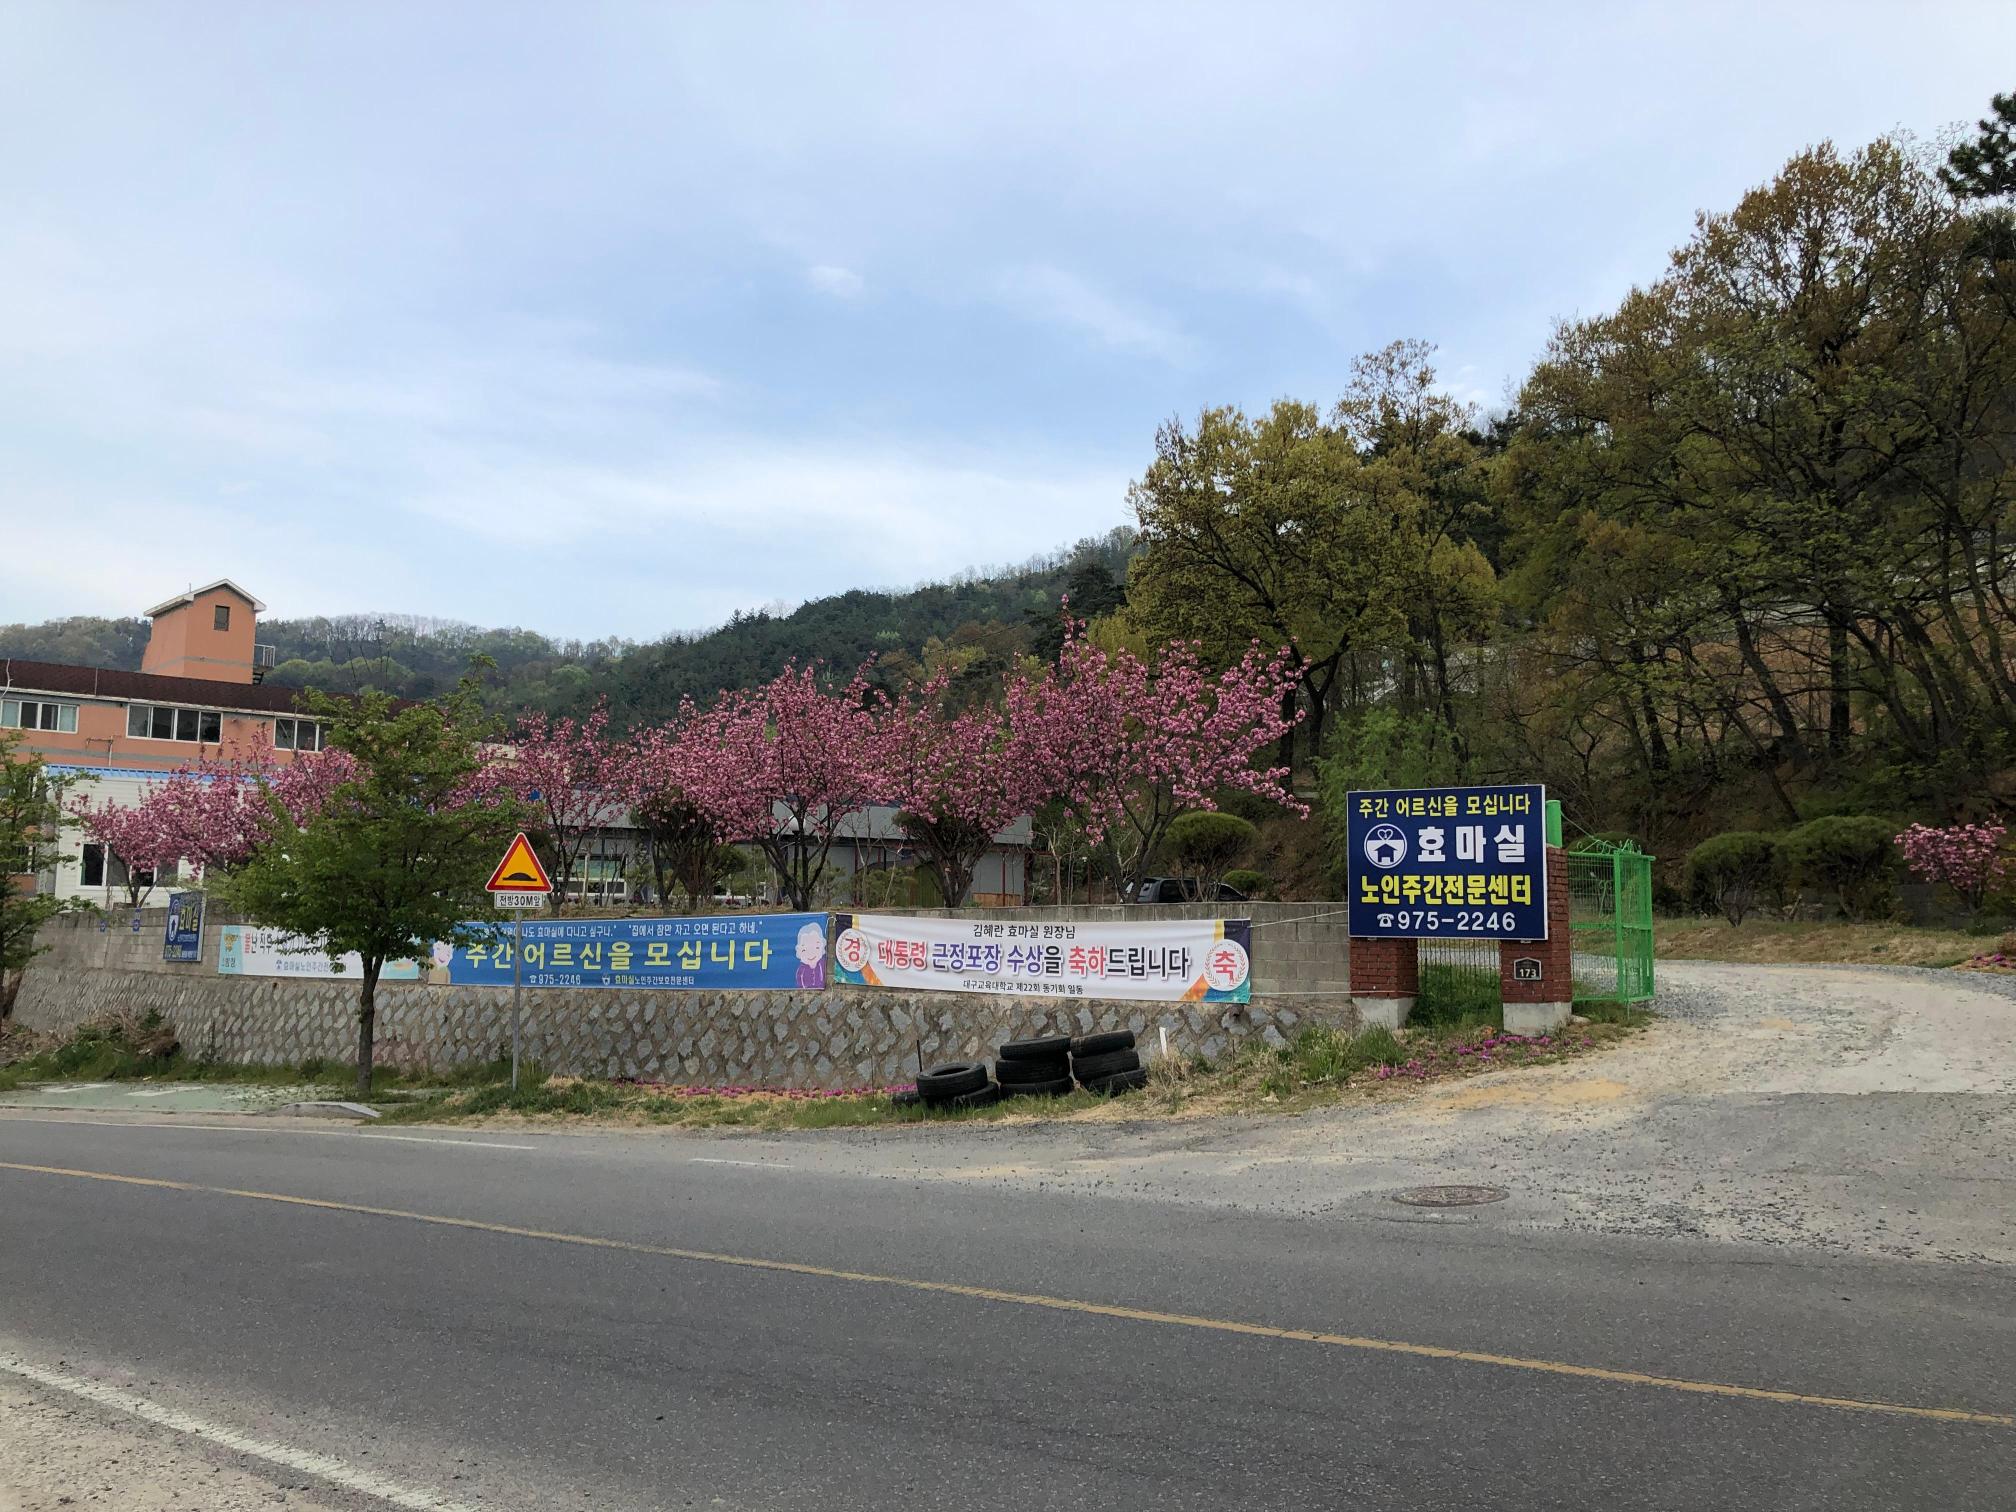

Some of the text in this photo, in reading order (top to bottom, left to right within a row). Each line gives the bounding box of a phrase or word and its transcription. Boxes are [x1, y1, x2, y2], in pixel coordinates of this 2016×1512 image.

[1359, 793, 1531, 819] 주간 어르신을 모십니다
[1417, 824, 1526, 863] 효마실
[500, 895, 541, 907] 전방30M앞
[1361, 874, 1531, 905] 노인주간전문센터
[537, 925, 564, 938] 효마실에
[566, 925, 587, 937] 다니고
[656, 924, 672, 937] 잠만
[674, 923, 690, 936] 자고
[693, 923, 709, 936] 오면
[711, 922, 736, 936] 된다고
[973, 924, 1076, 939] 김혜란 효마실 원장님
[1397, 911, 1516, 931] 975-2246
[465, 938, 773, 971] 주간 어르신을 모십니다
[844, 937, 861, 963] 경
[877, 939, 1190, 978] 대통령 근정포장 수상을 축하드립니다
[1213, 950, 1238, 982] 축
[1519, 968, 1537, 978] 173
[538, 973, 581, 985] 975-2246
[963, 979, 1084, 995] 대구교육대학교 제22회 동기회 일동
